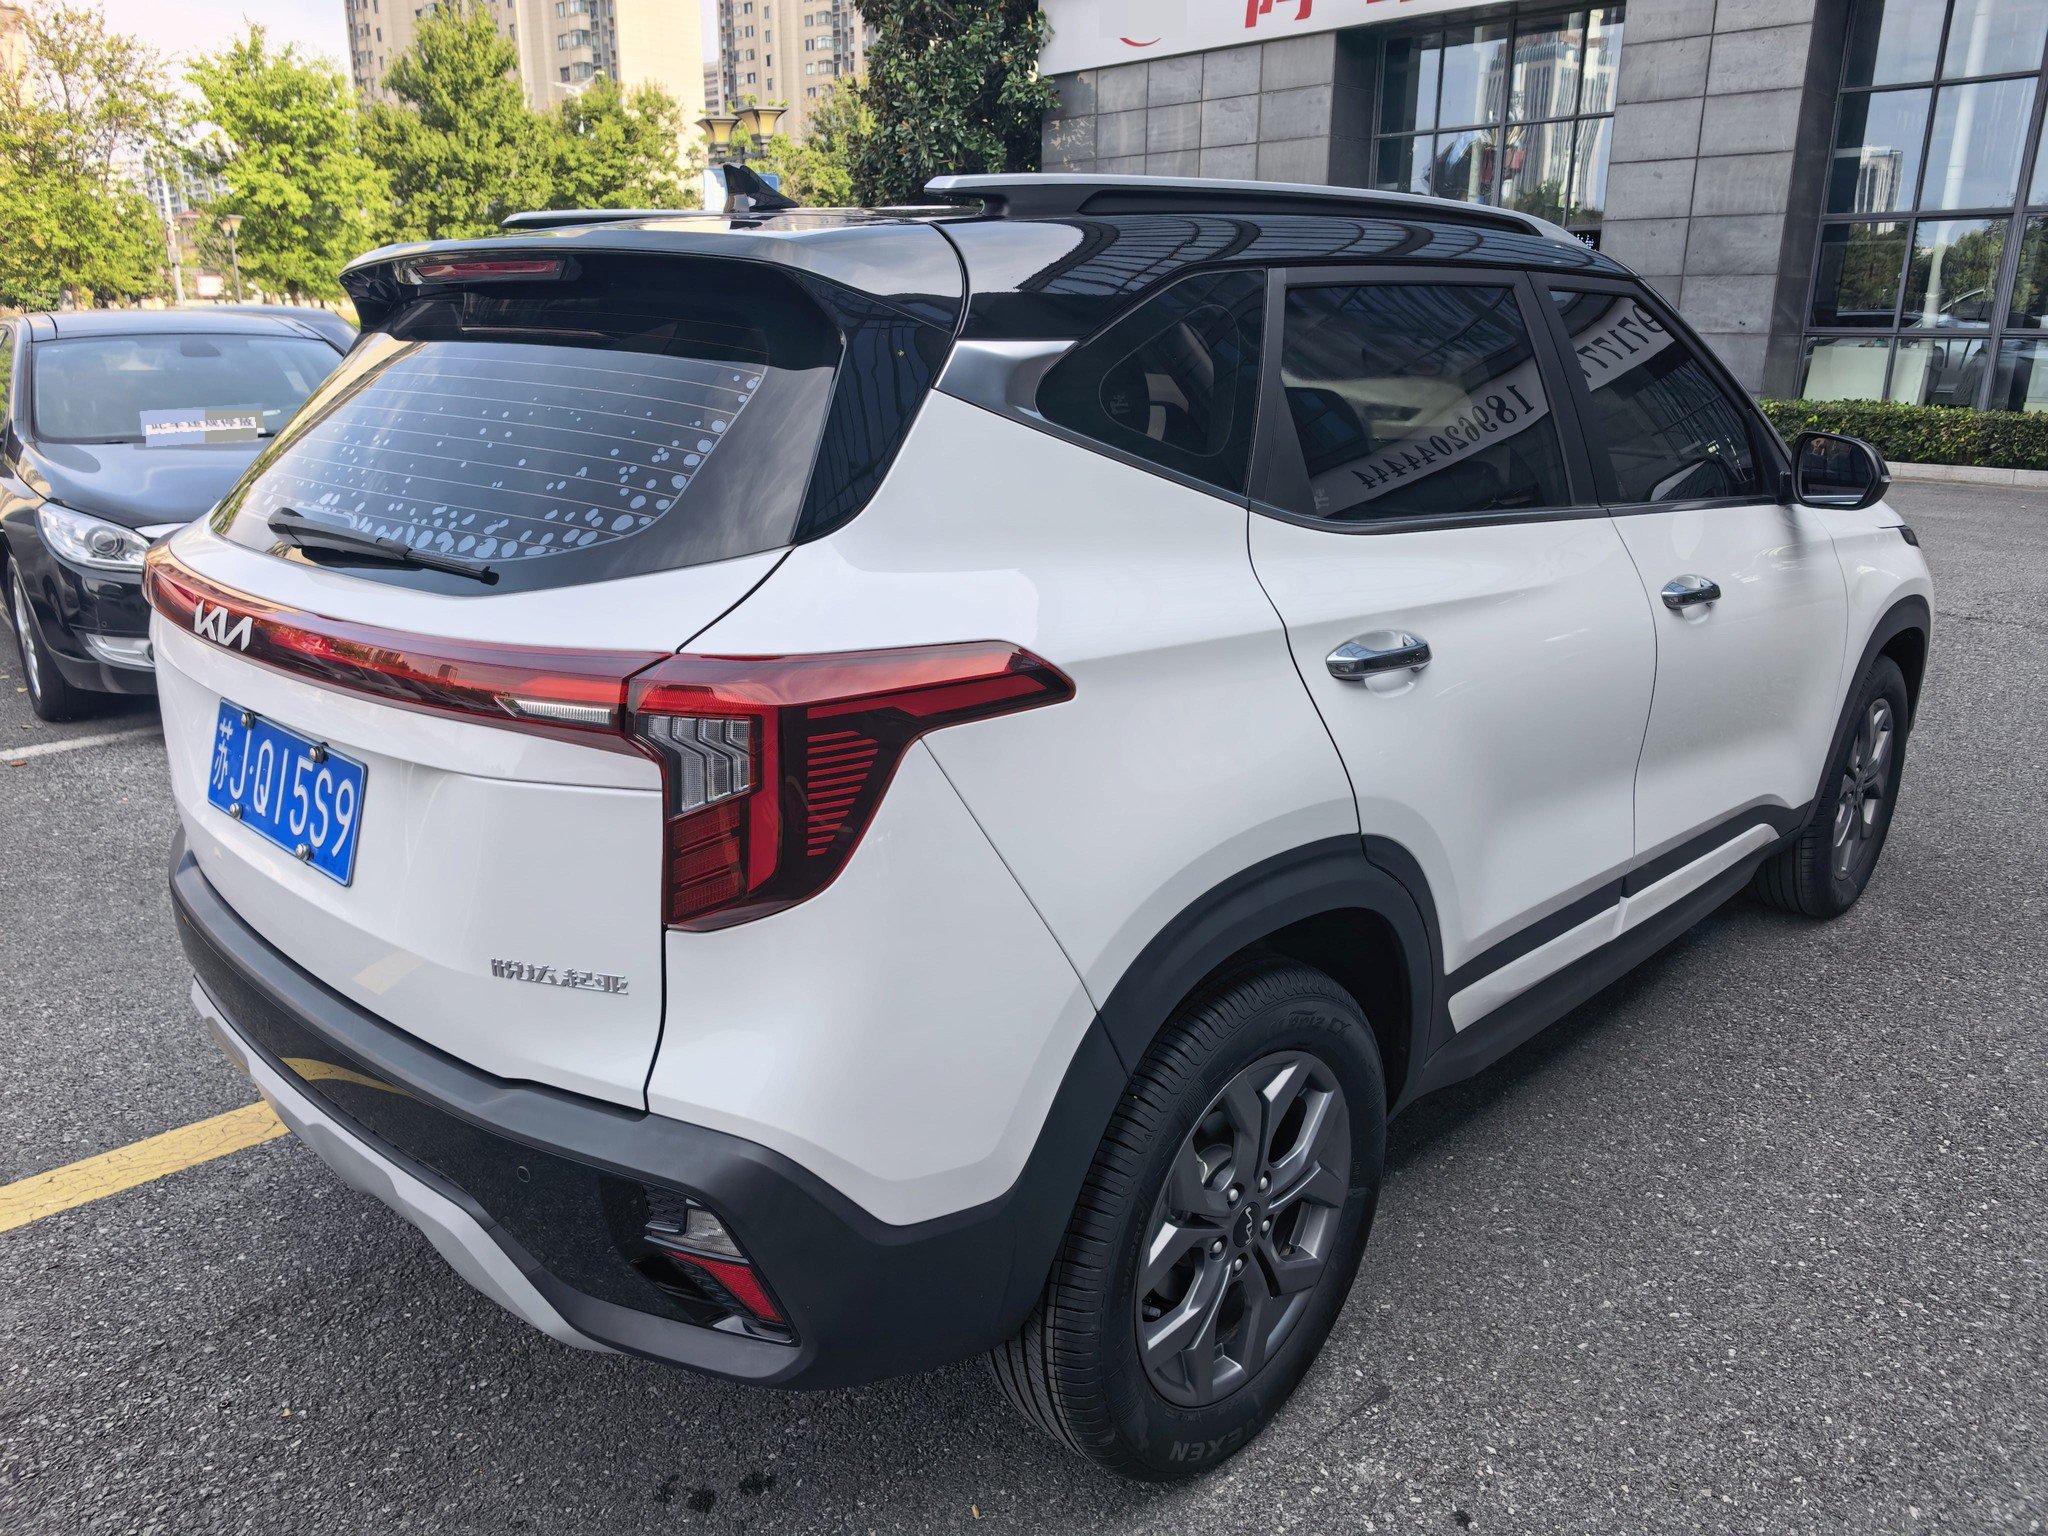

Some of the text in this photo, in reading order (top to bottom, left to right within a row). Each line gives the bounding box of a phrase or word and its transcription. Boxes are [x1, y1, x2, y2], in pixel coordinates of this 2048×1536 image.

[194, 600, 254, 651] KIA
[491, 957, 629, 995] 悦达起亚
